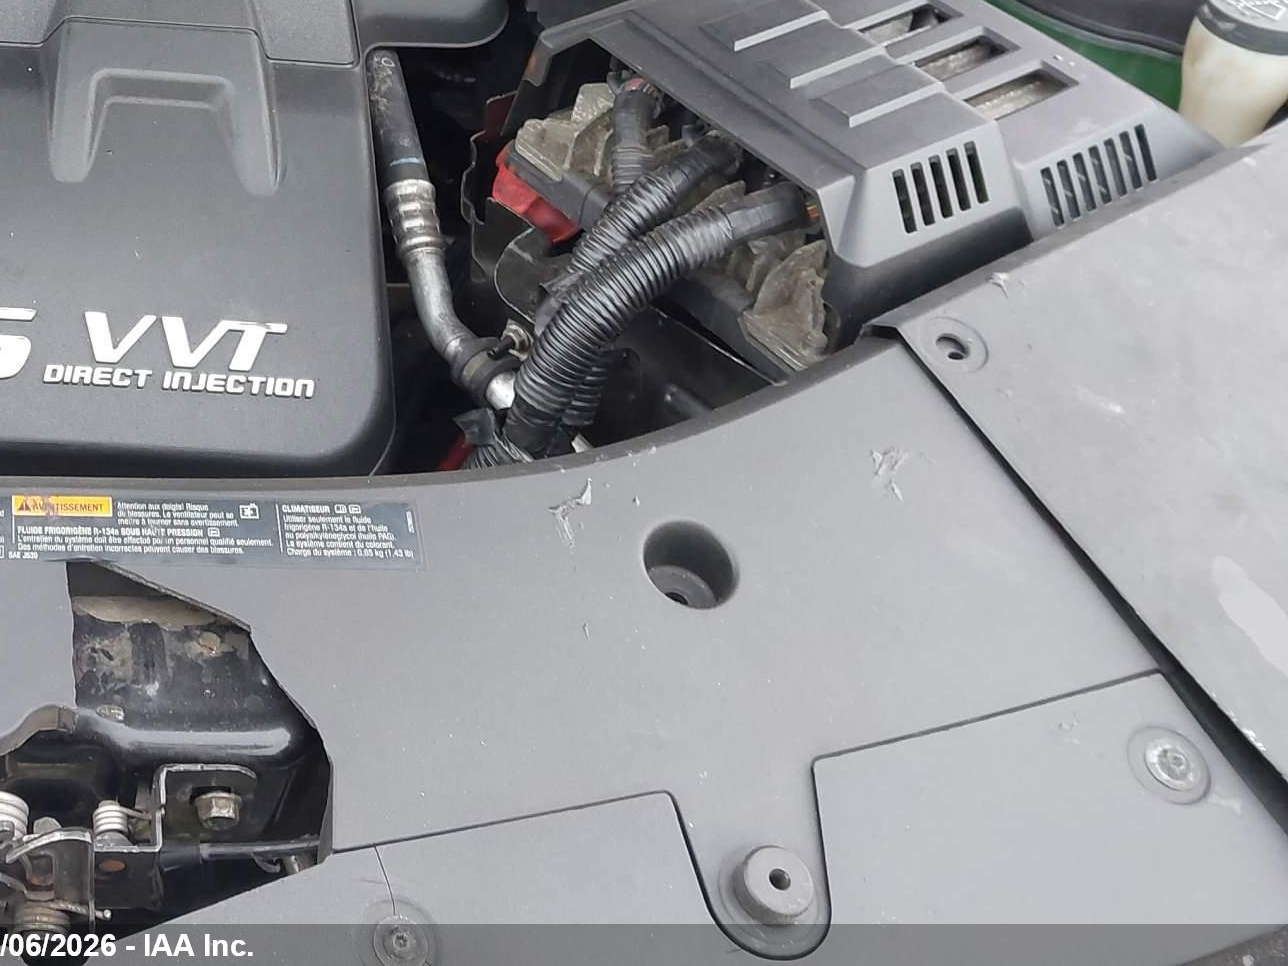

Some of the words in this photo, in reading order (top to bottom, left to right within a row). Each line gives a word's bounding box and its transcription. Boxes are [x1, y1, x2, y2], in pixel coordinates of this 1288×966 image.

[84, 310, 289, 372] VVT
[43, 364, 152, 389] DIRECT
[162, 370, 314, 399] INJECTION
[117, 501, 147, 510] Attention
[185, 503, 208, 512] Risque
[281, 504, 330, 514] CLIMATISEUR
[117, 510, 126, 518] de
[172, 511, 208, 519] ventilateur
[209, 512, 224, 520] peut
[283, 515, 306, 523] Utiliser
[307, 515, 344, 524] seulement
[352, 516, 371, 524] fluide
[17, 525, 43, 534] FLUIDE
[93, 527, 119, 535] R-134a
[120, 527, 140, 536] SOUS
[141, 528, 165, 536] HAUTE
[166, 528, 203, 537] PRESSION
[321, 523, 347, 532] R-134a
[348, 524, 356, 532] et
[357, 524, 366, 532] de
[54, 535, 63, 543] du
[175, 538, 209, 546] personnel
[325, 541, 353, 549] contient
[355, 541, 364, 549] du
[17, 543, 31, 551] Des
[104, 544, 142, 553] incorrectes
[143, 546, 171, 554] peuvent
[172, 546, 194, 554] causer
[196, 546, 209, 554] des
[286, 548, 311, 557] Charge
[312, 548, 322, 556] du
[374, 549, 384, 559] kg
[8, 551, 21, 559] SAE
